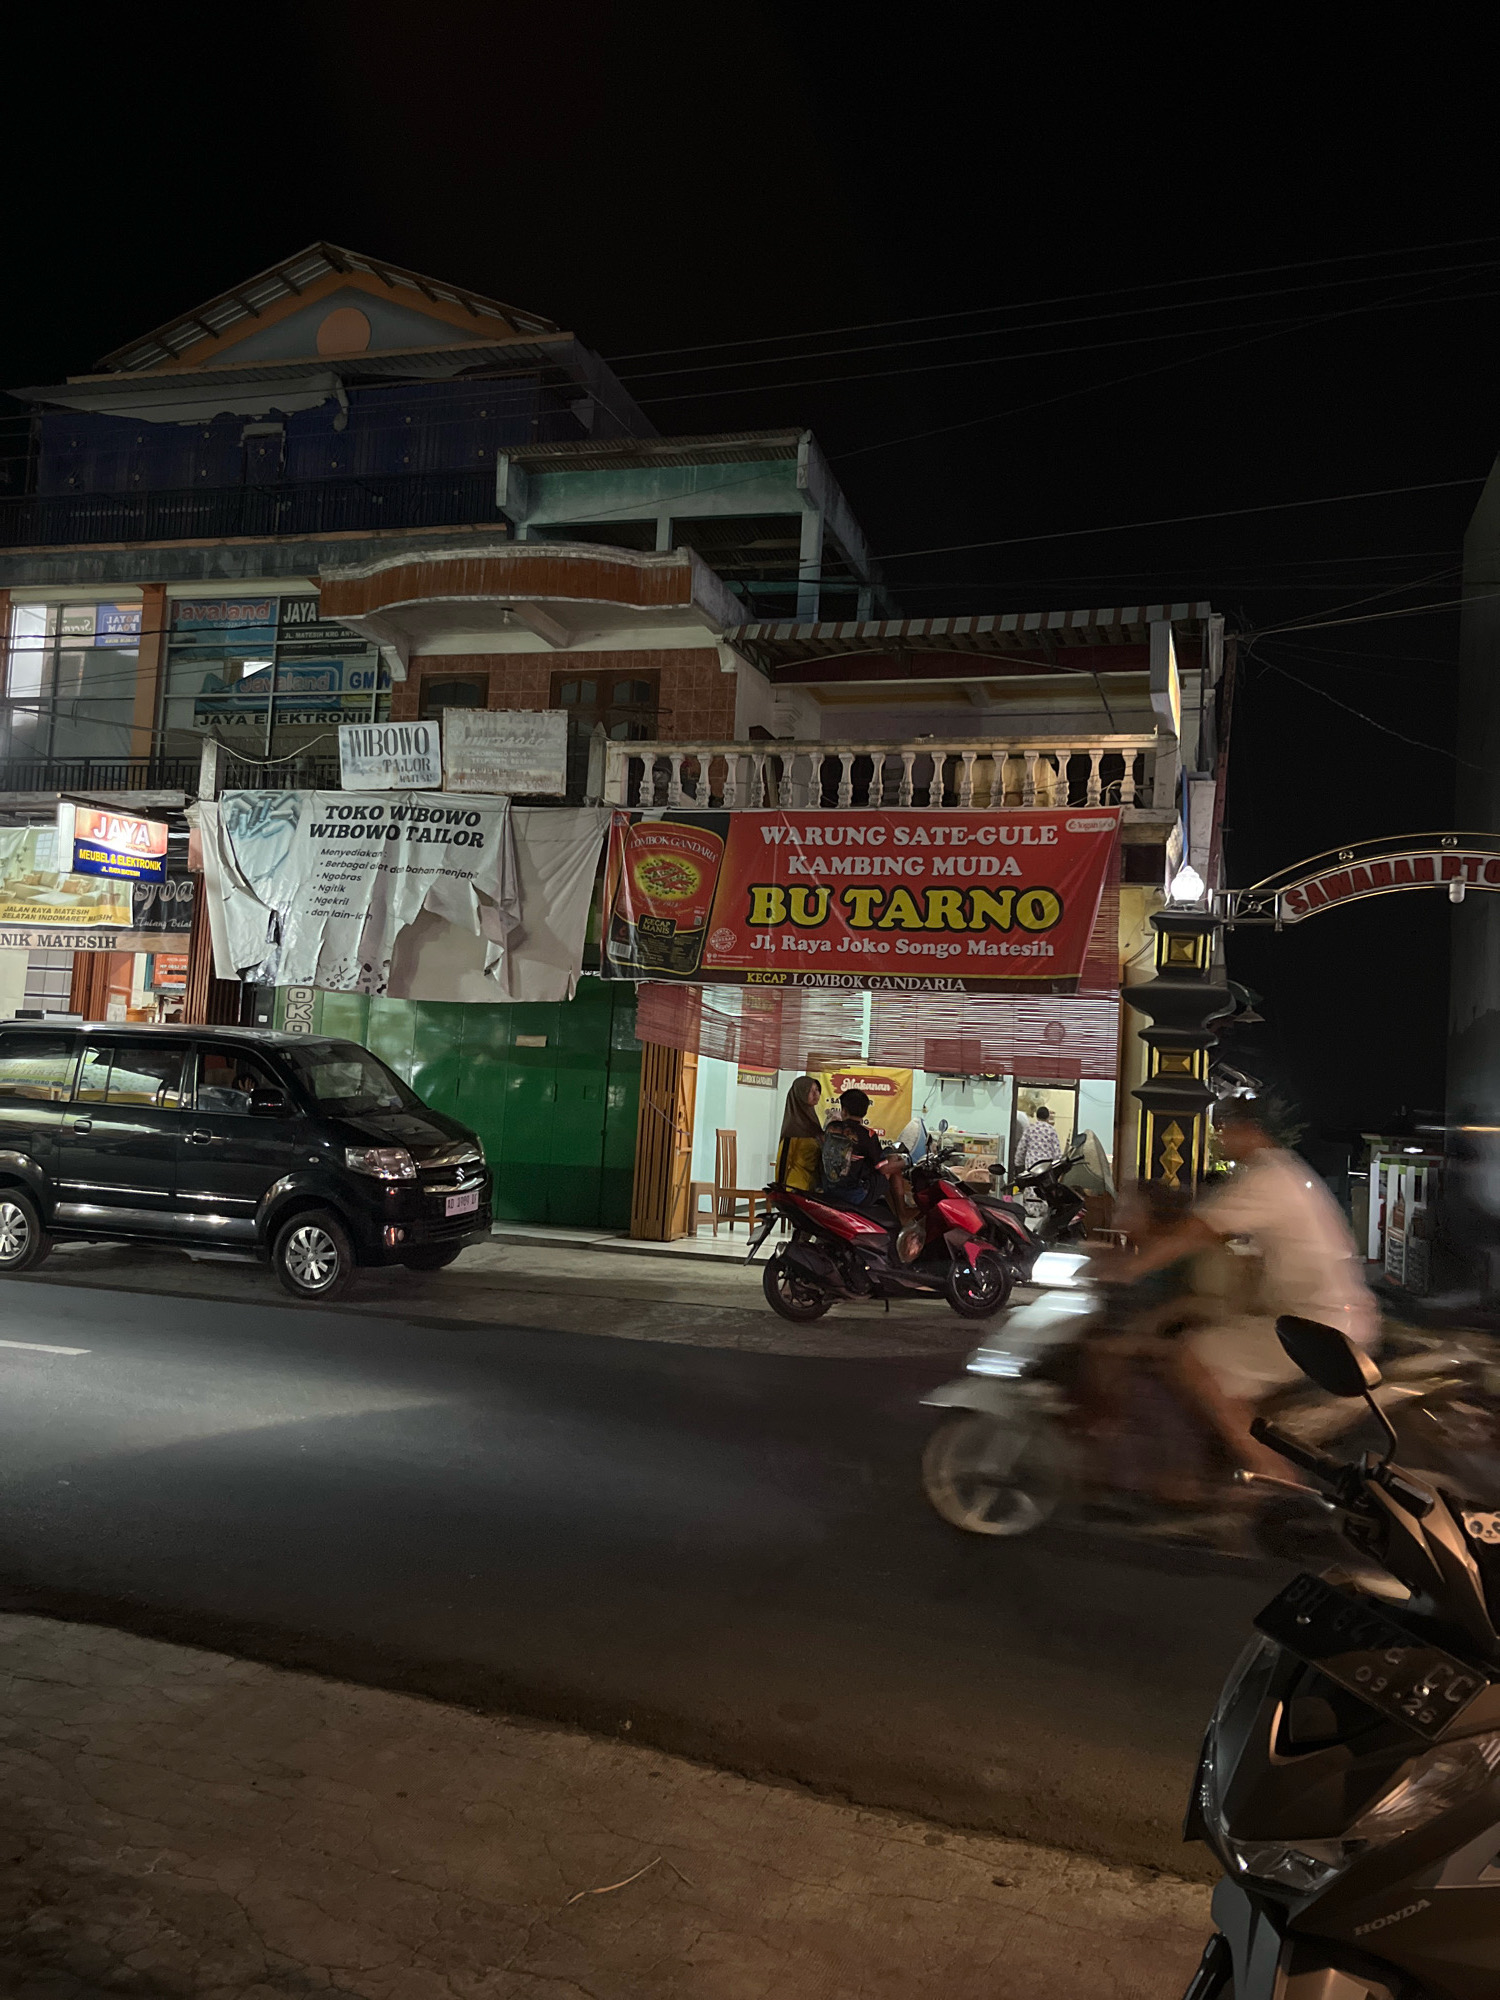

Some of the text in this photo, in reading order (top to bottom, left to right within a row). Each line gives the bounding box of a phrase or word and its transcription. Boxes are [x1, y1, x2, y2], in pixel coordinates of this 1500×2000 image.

[283, 602, 317, 623] JAYA
[200, 714, 248, 726] JAYA
[349, 727, 430, 757] WIBOWO
[325, 806, 481, 827] TOKO WIBOWO
[93, 816, 151, 847] JAYA
[310, 824, 485, 848] WIBOWO TAILOR
[760, 825, 1058, 846] WARUNG SATE-GULE
[630, 835, 717, 863] LOMBOK GANDARIA
[79, 849, 161, 871] MEUBEL & ELEKTRONIK
[325, 861, 369, 871] Berbagai
[405, 865, 435, 875] bahan
[788, 856, 1022, 876] KAMBING MUDA
[321, 872, 362, 882] Ngobras
[1285, 857, 1434, 914] SAWAHAN
[317, 884, 346, 893] Ngitik
[331, 910, 373, 920] lain-lan
[747, 884, 1062, 931] BU TARNO
[38, 914, 87, 922] INDOMARET
[644, 918, 671, 927] KECAP
[641, 924, 670, 935] MANIS
[37, 934, 118, 949] MATESIH
[781, 935, 832, 957] Raya
[837, 937, 890, 955] Joko
[895, 939, 961, 959] Songo
[966, 940, 1054, 957] Matesih
[746, 972, 966, 992] KECAP LOMBOK GANDARIA
[840, 1078, 891, 1092] Makanan
[1354, 1899, 1432, 1936] HONDA
